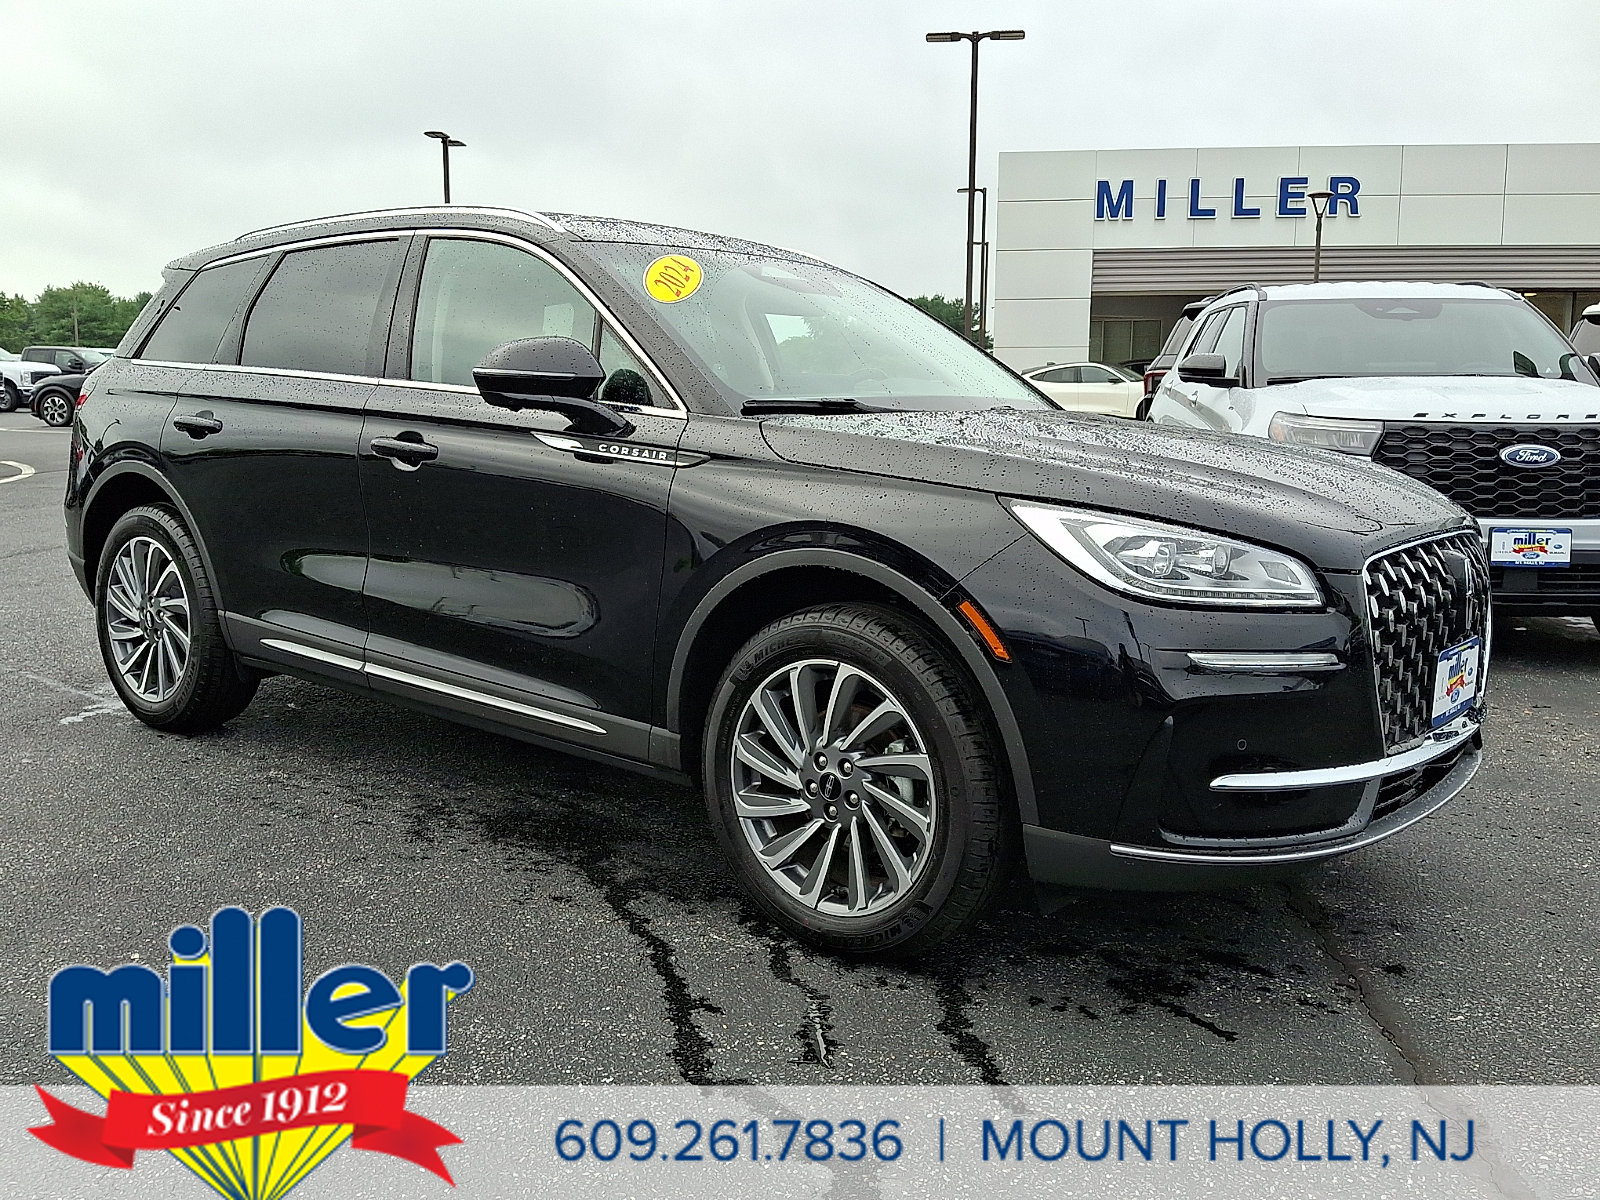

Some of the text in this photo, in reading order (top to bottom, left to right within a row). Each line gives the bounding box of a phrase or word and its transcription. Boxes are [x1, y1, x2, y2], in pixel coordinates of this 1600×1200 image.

[1094, 176, 1361, 221] MILLER
[654, 257, 694, 297] 2024
[598, 444, 667, 460] CORSAIR
[1516, 450, 1547, 462] Ford
[1513, 533, 1551, 545] miller
